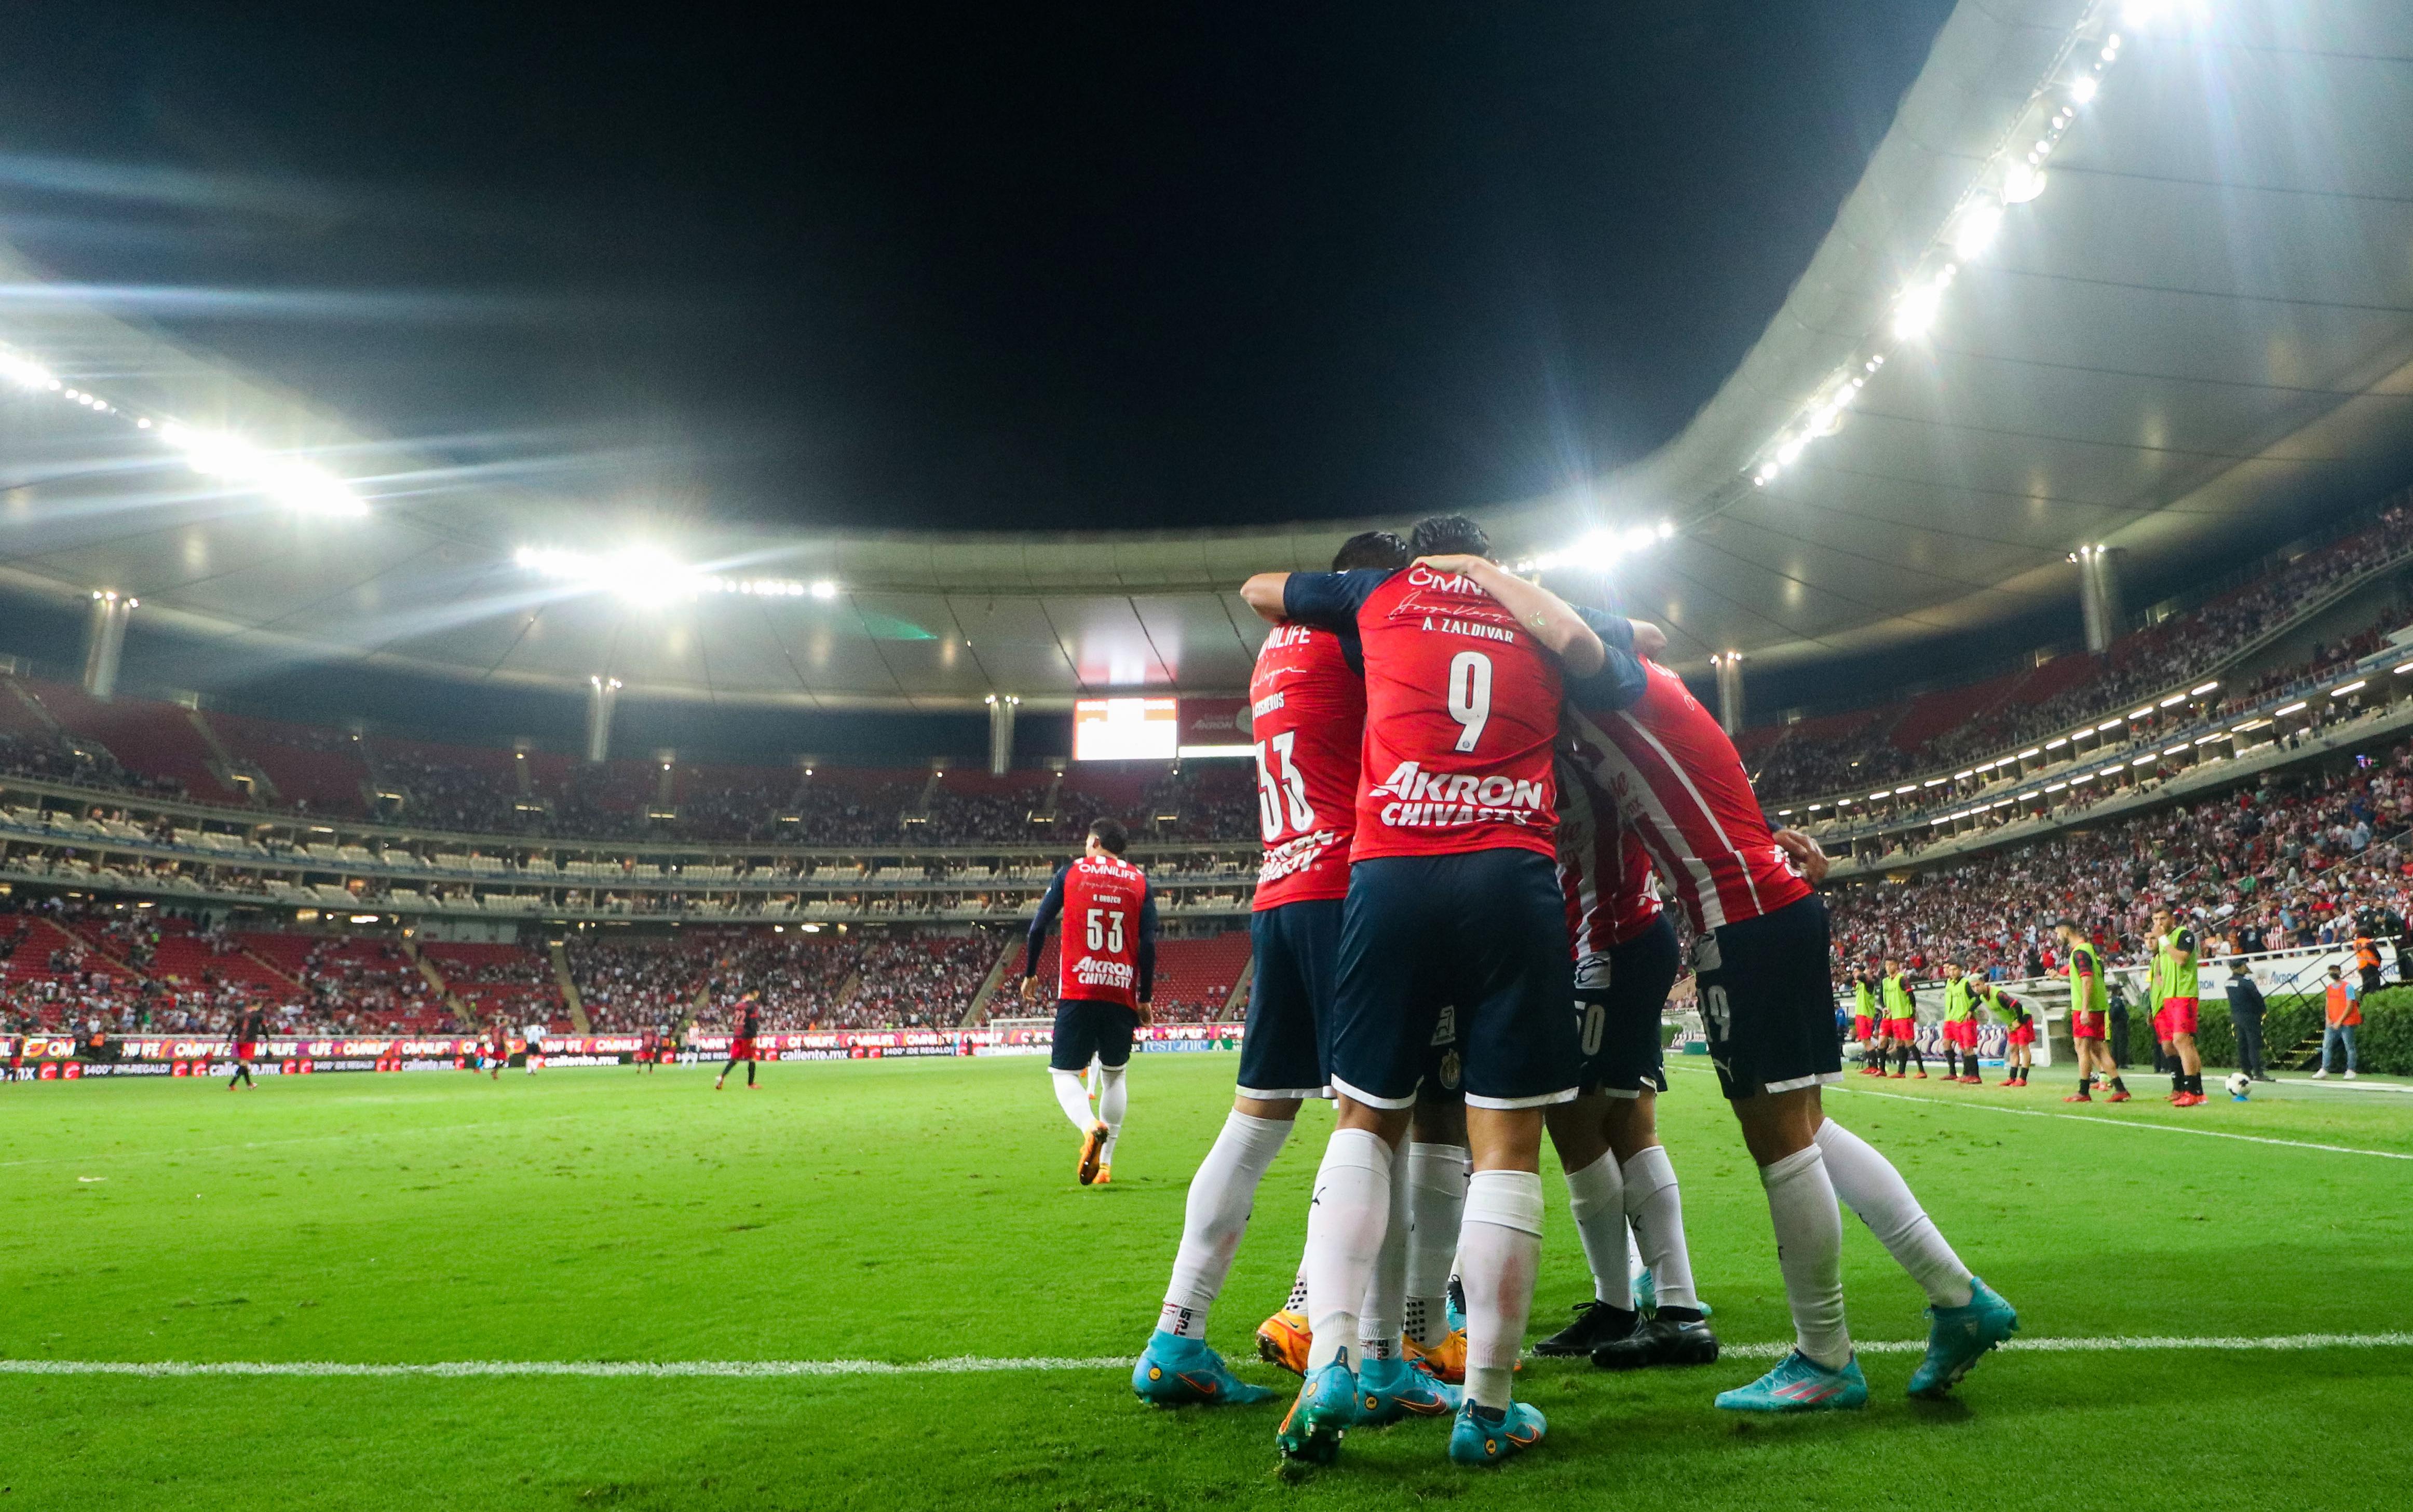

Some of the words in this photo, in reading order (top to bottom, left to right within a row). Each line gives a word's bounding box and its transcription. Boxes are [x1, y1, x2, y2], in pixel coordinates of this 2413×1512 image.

[1422, 616, 1436, 632] A.
[1441, 618, 1515, 643] ZALDIVAR
[1254, 691, 1285, 718] CISNEROS
[1448, 651, 1493, 753] 9
[1255, 730, 1315, 842] 33
[1369, 761, 1543, 810] AKRON
[1079, 864, 1137, 881] OMNILIFE
[1087, 908, 1124, 953] 53
[1072, 956, 1134, 977] AKRON
[544, 1055, 619, 1067] caliente.mx
[780, 1048, 848, 1060] caliente.mx
